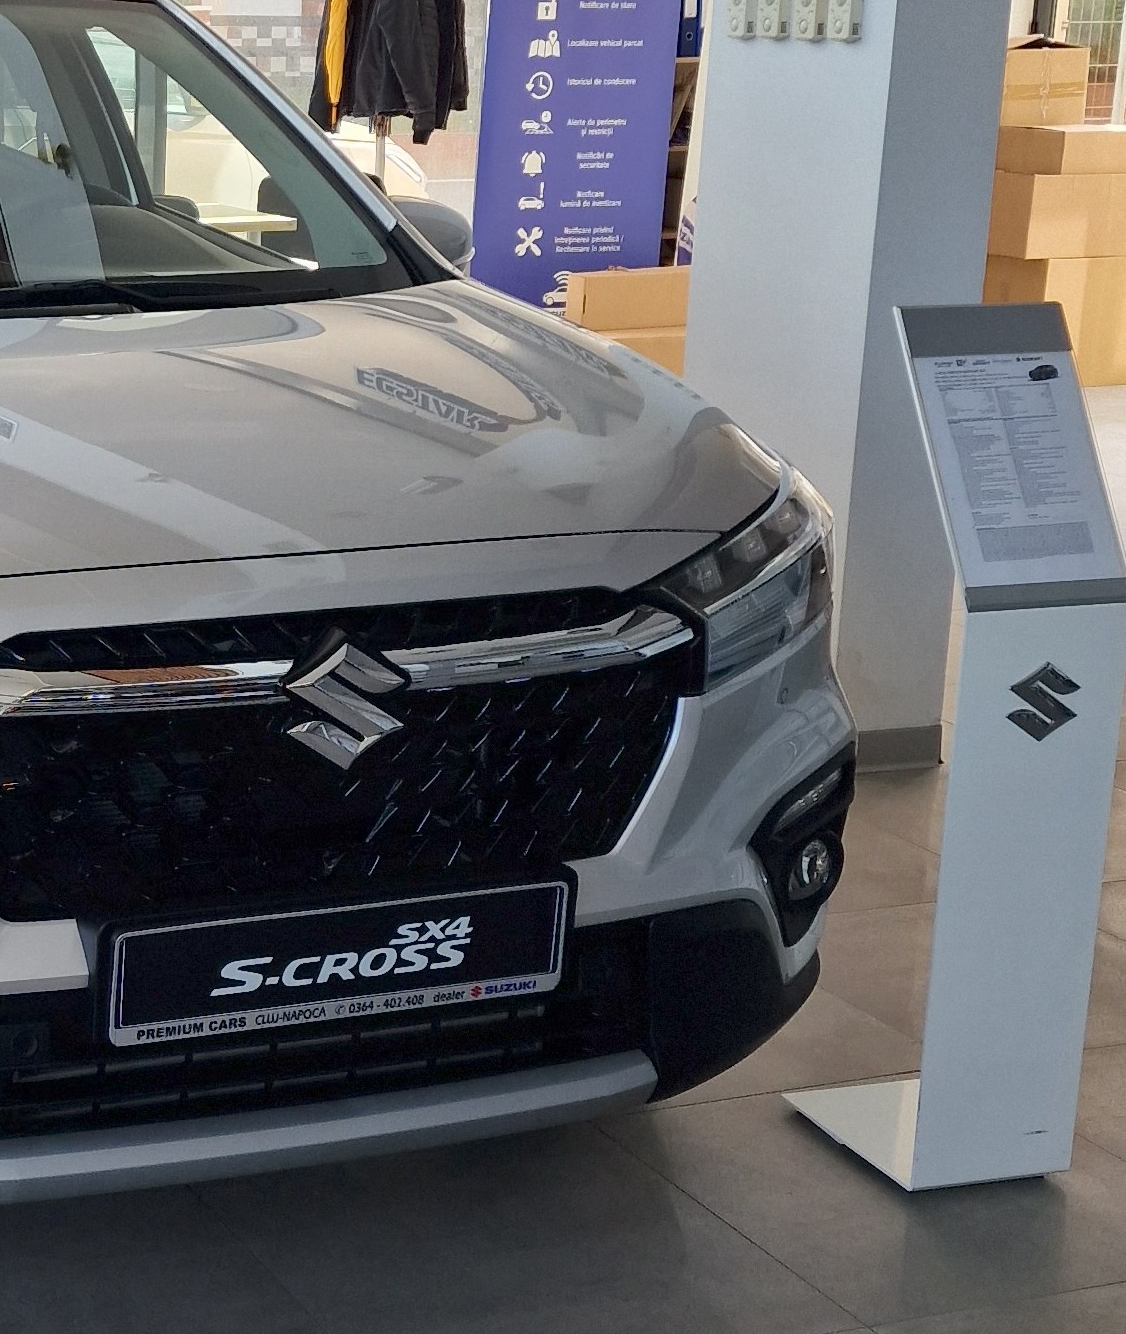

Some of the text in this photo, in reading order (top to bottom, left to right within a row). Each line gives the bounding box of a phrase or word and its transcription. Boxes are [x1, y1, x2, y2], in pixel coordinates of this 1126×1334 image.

[389, 915, 474, 946] SX4
[210, 938, 471, 997] S-CROSS
[136, 1023, 205, 1041] PREMIUM
[208, 1016, 248, 1033] CARS
[254, 1006, 327, 1026] CLUJ-NAPOCA
[348, 999, 374, 1014] 0364
[382, 994, 425, 1010] 402.408
[432, 989, 466, 1004] dealer
[484, 979, 538, 995] SUZUKI
